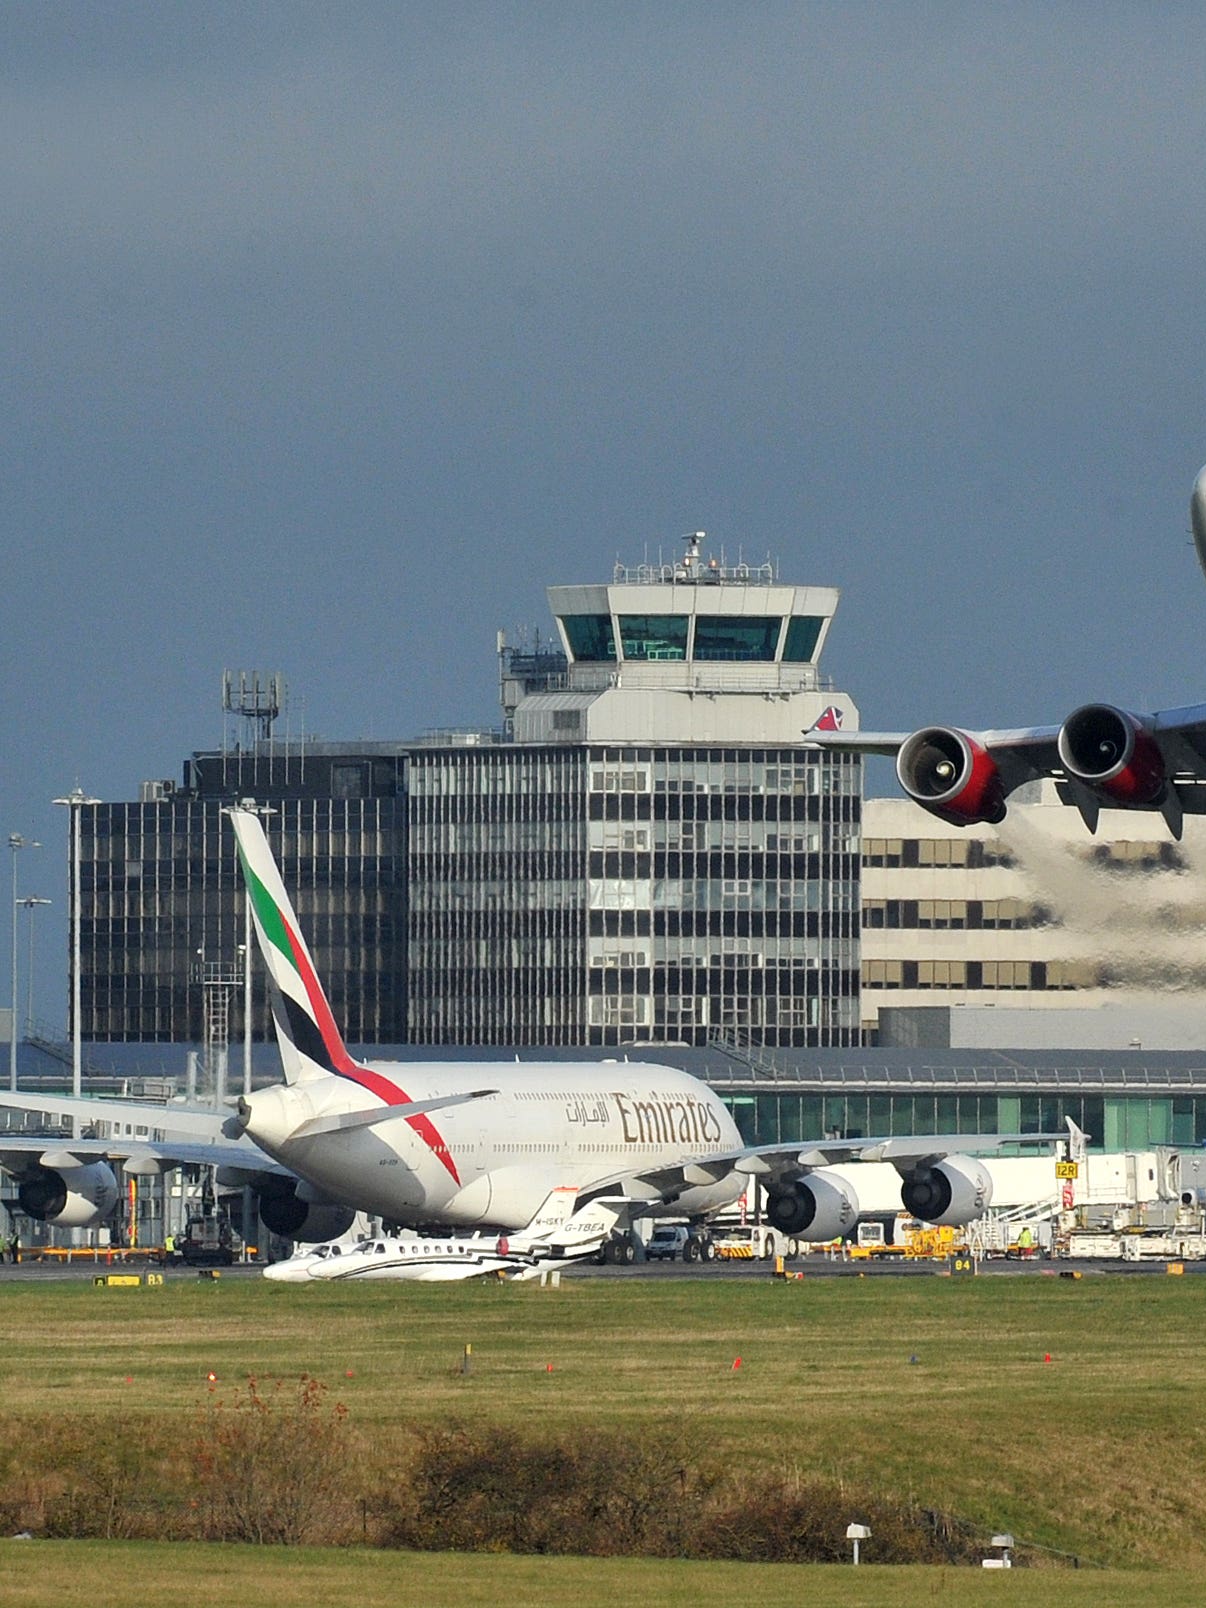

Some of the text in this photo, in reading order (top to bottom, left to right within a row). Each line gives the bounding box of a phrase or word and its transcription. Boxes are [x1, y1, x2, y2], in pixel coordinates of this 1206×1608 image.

[611, 1091, 721, 1143] Emirates
[1057, 1165, 1075, 1176] 12R
[564, 1222, 605, 1232] G-TBEA
